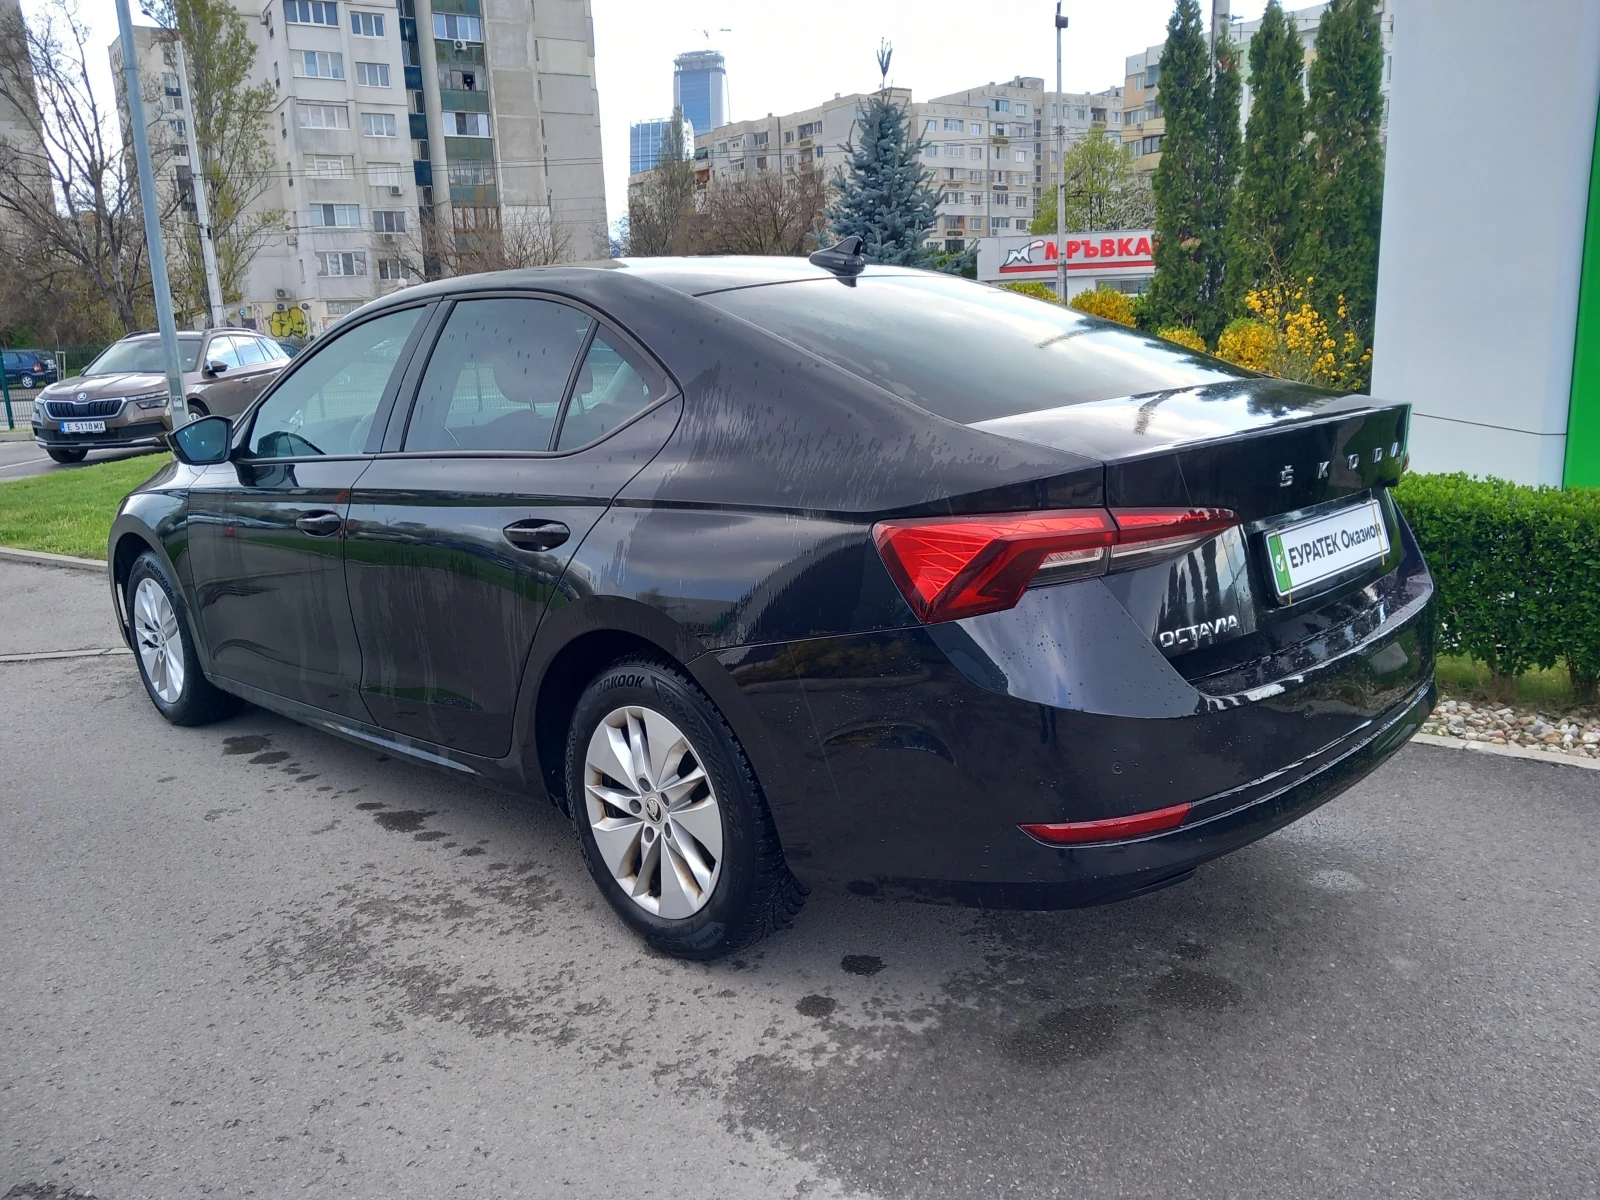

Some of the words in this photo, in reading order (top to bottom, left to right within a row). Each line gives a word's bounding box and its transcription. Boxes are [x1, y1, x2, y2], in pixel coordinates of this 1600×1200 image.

[1288, 534, 1341, 568] ЕУРАТЕК
[1341, 523, 1382, 548] Оказион
[1159, 615, 1240, 648] OCTAVIA
